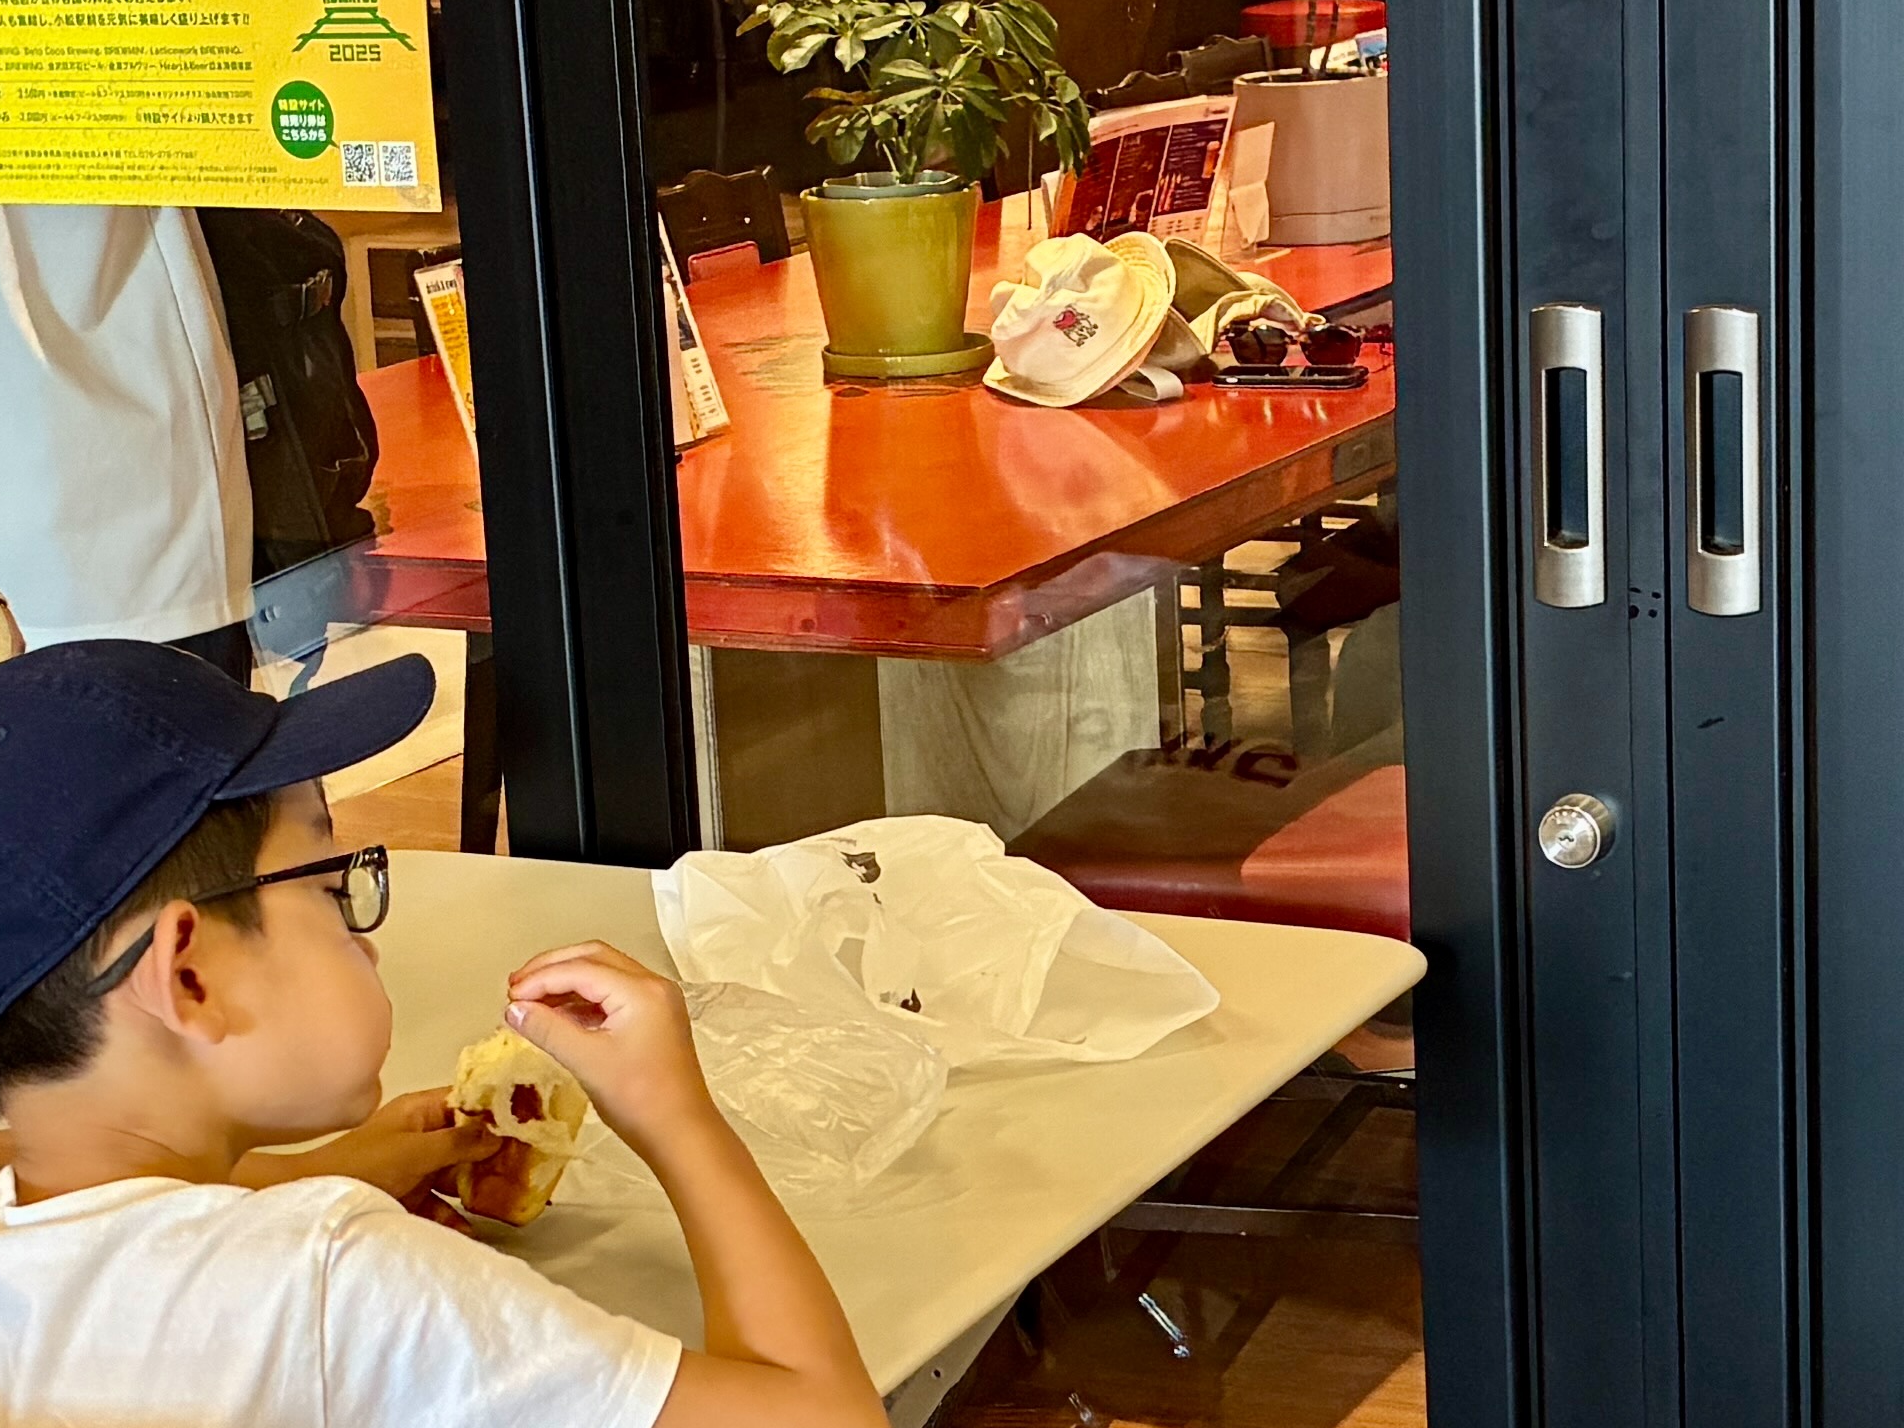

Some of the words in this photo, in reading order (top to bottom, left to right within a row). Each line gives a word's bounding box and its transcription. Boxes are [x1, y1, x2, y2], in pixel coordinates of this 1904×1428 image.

[329, 44, 381, 61] 2025
[282, 129, 326, 141] こちらから
